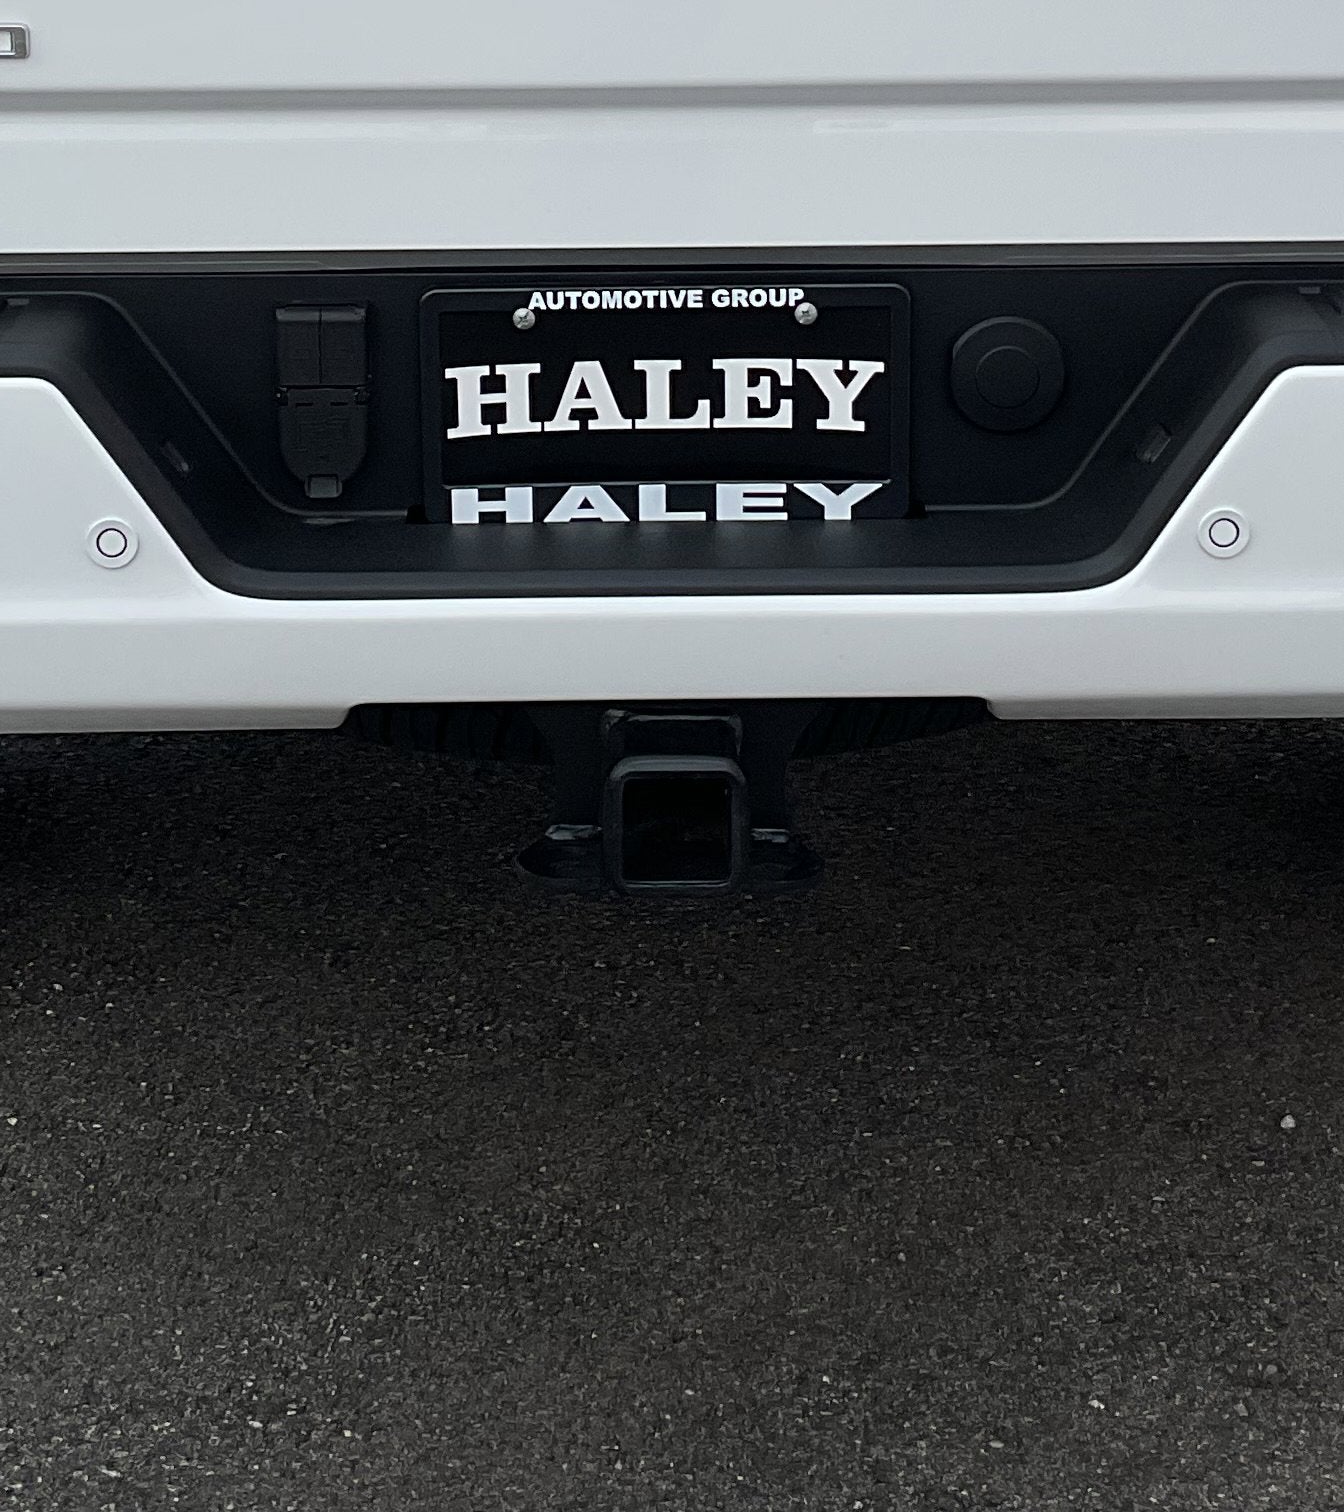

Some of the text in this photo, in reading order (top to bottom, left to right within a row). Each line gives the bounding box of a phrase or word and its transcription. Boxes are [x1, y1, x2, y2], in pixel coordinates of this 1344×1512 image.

[527, 288, 805, 311] AUTOMOTIVE GROUP
[444, 357, 886, 440] HALEY
[450, 482, 884, 525] HALEY
